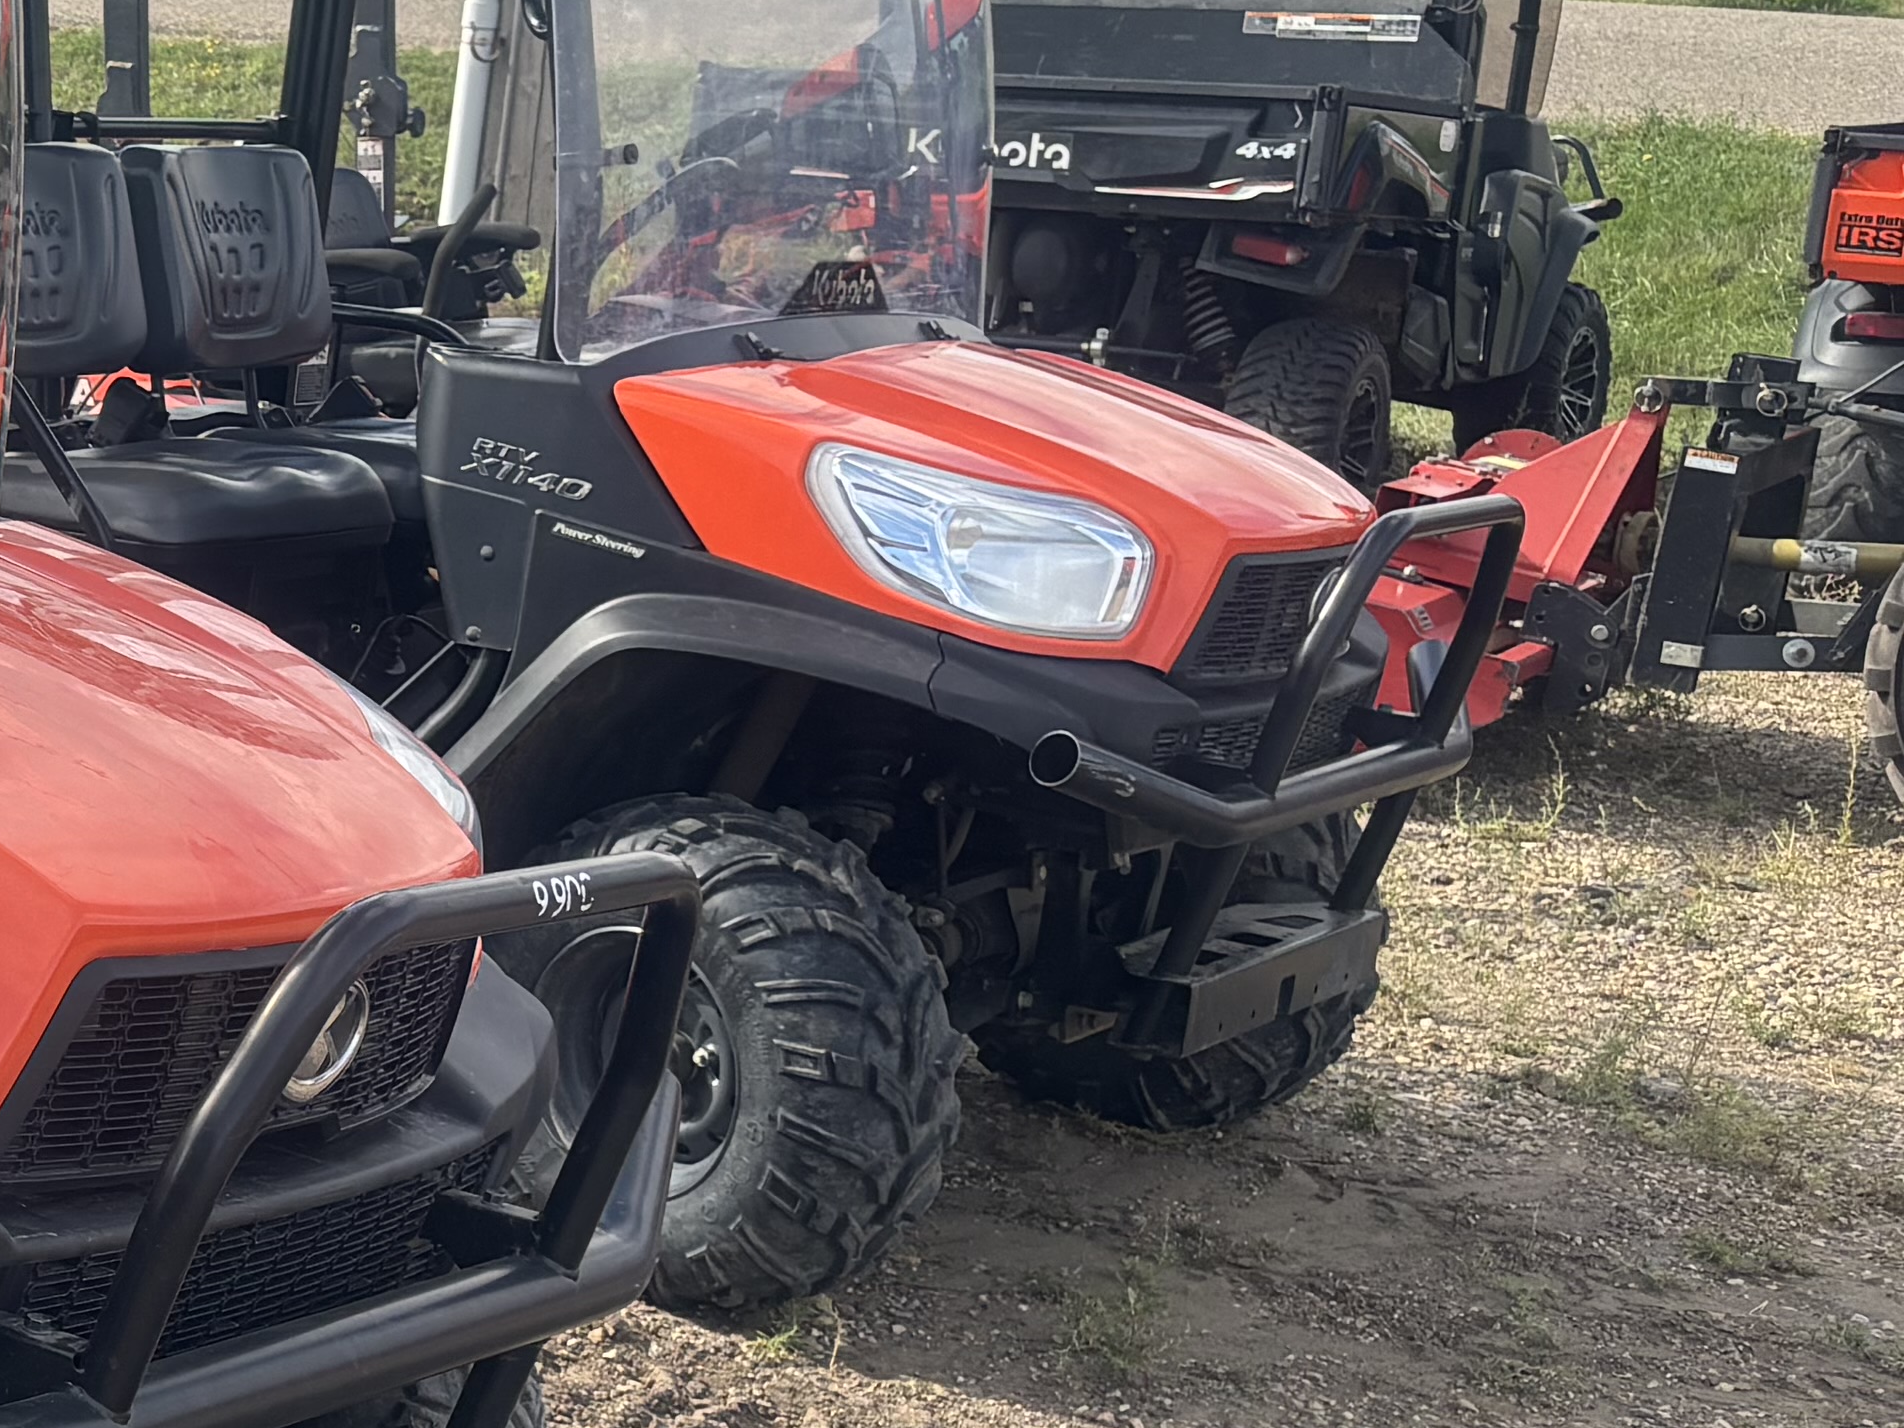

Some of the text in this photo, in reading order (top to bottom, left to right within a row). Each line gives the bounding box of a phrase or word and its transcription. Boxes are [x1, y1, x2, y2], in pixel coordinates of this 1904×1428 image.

[1235, 141, 1296, 160] 4x4
[1837, 225, 1903, 250] IRS
[812, 268, 875, 308] Kubota
[472, 436, 541, 463] RTV
[459, 451, 593, 501] X1140
[552, 521, 646, 559] Power Steering
